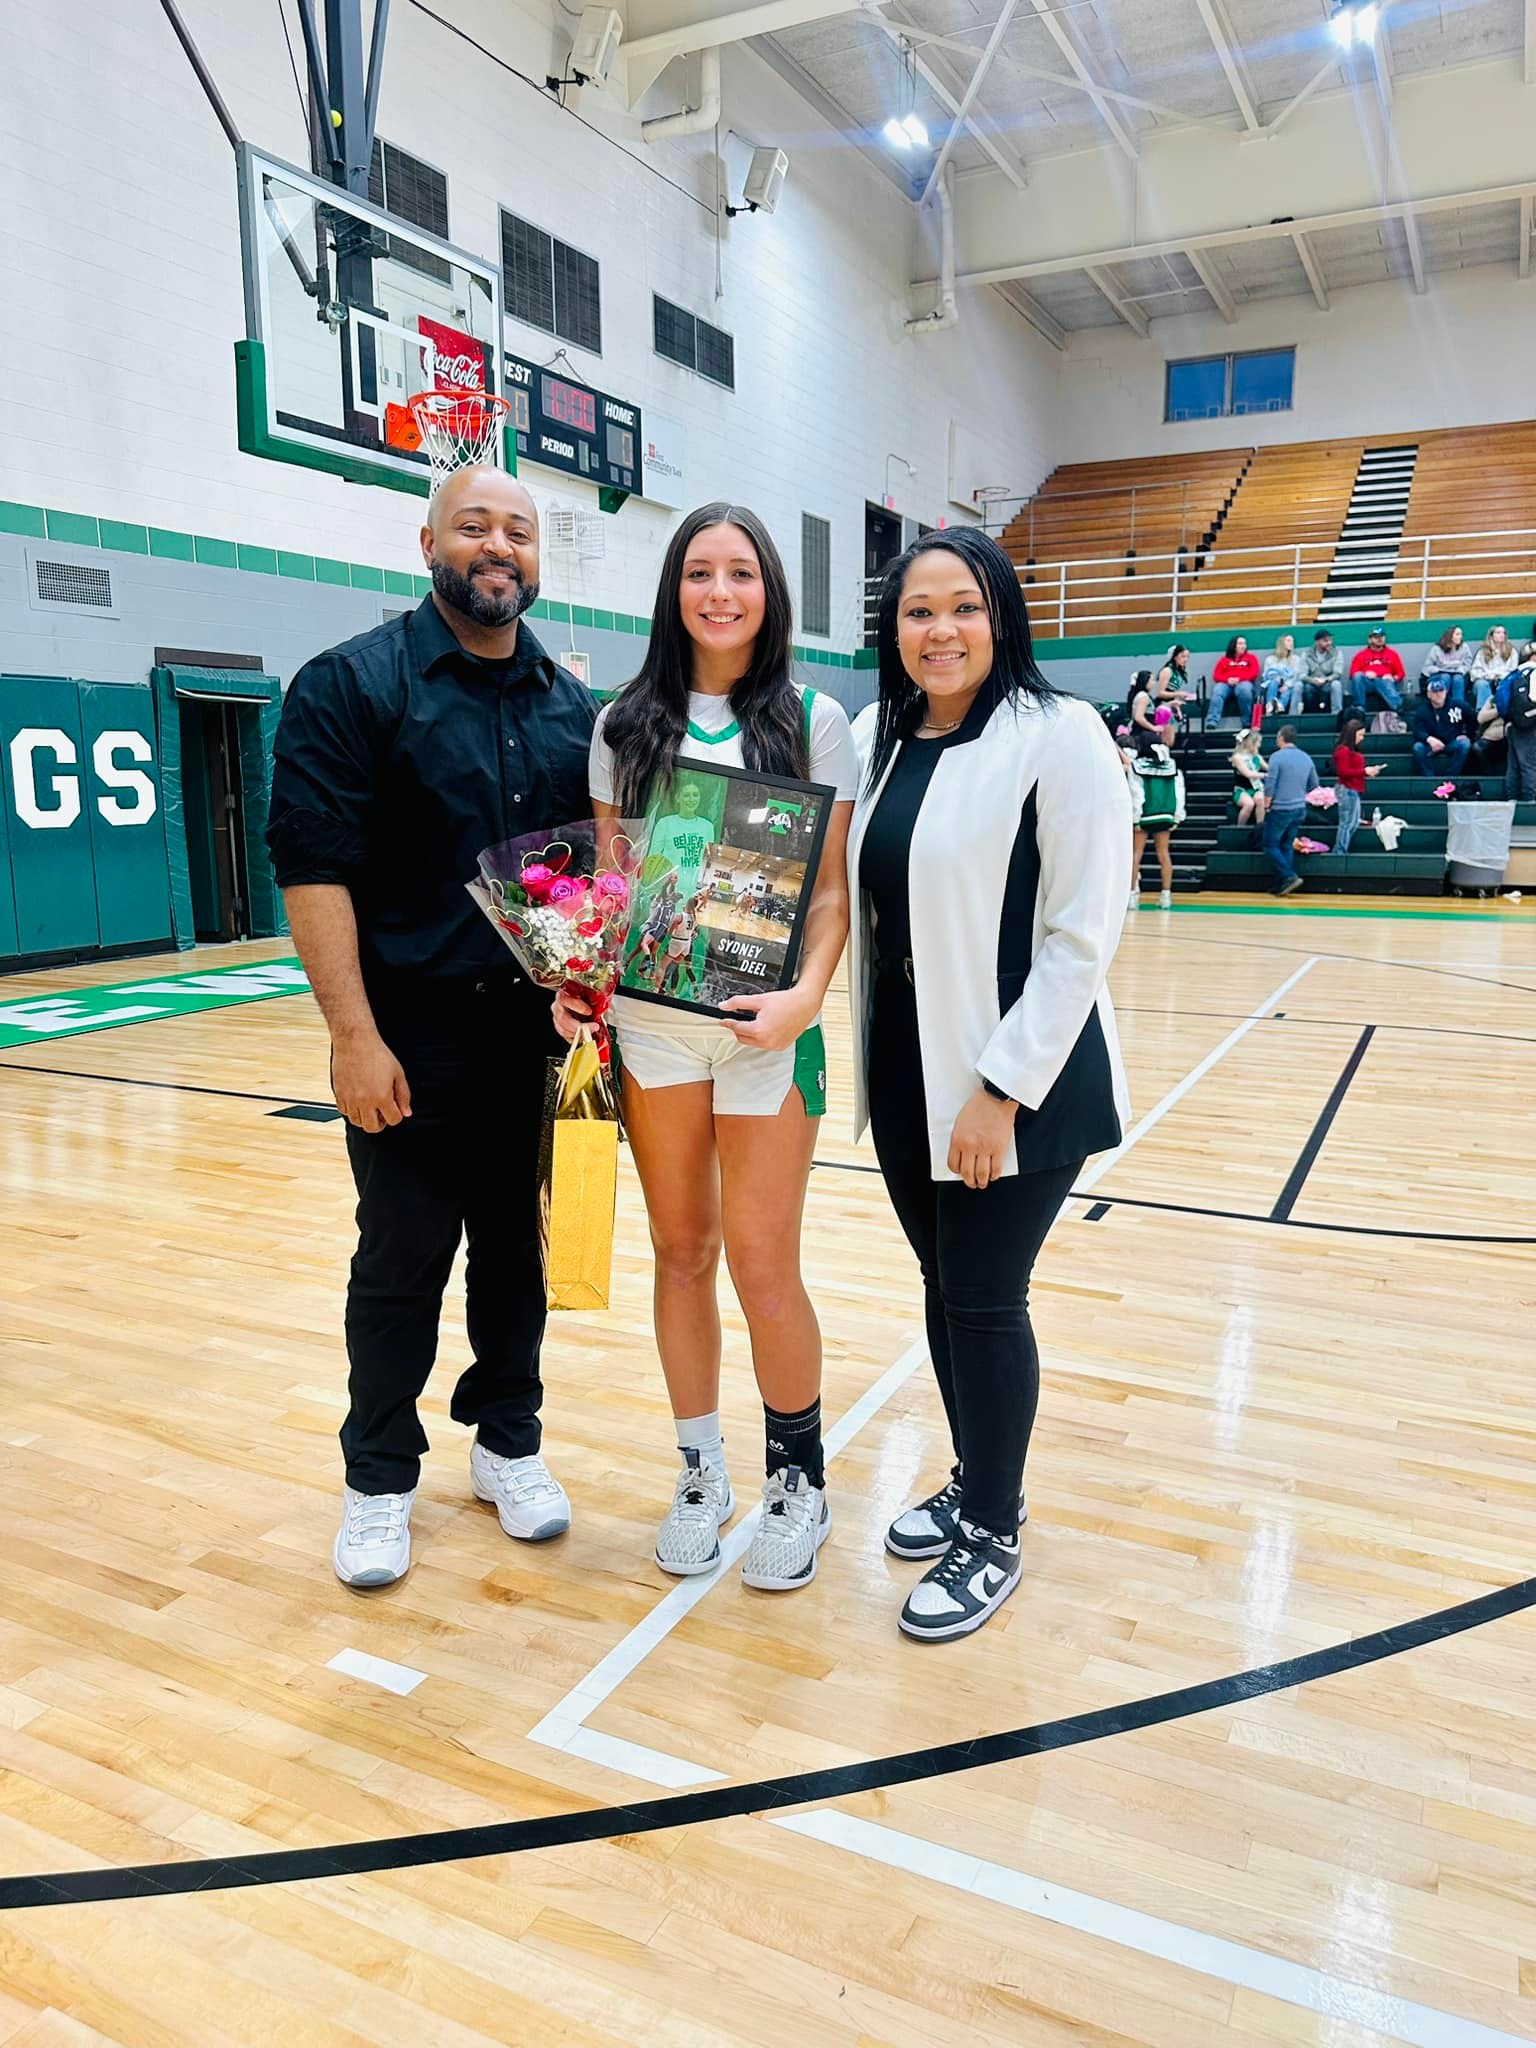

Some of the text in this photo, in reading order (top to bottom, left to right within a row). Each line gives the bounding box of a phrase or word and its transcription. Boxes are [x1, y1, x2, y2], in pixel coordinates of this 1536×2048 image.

[503, 359, 532, 384] EST
[604, 400, 635, 426] HOME
[541, 436, 575, 458] PERIOD
[717, 938, 764, 959] SYDNEY
[739, 959, 768, 977] DEEL
